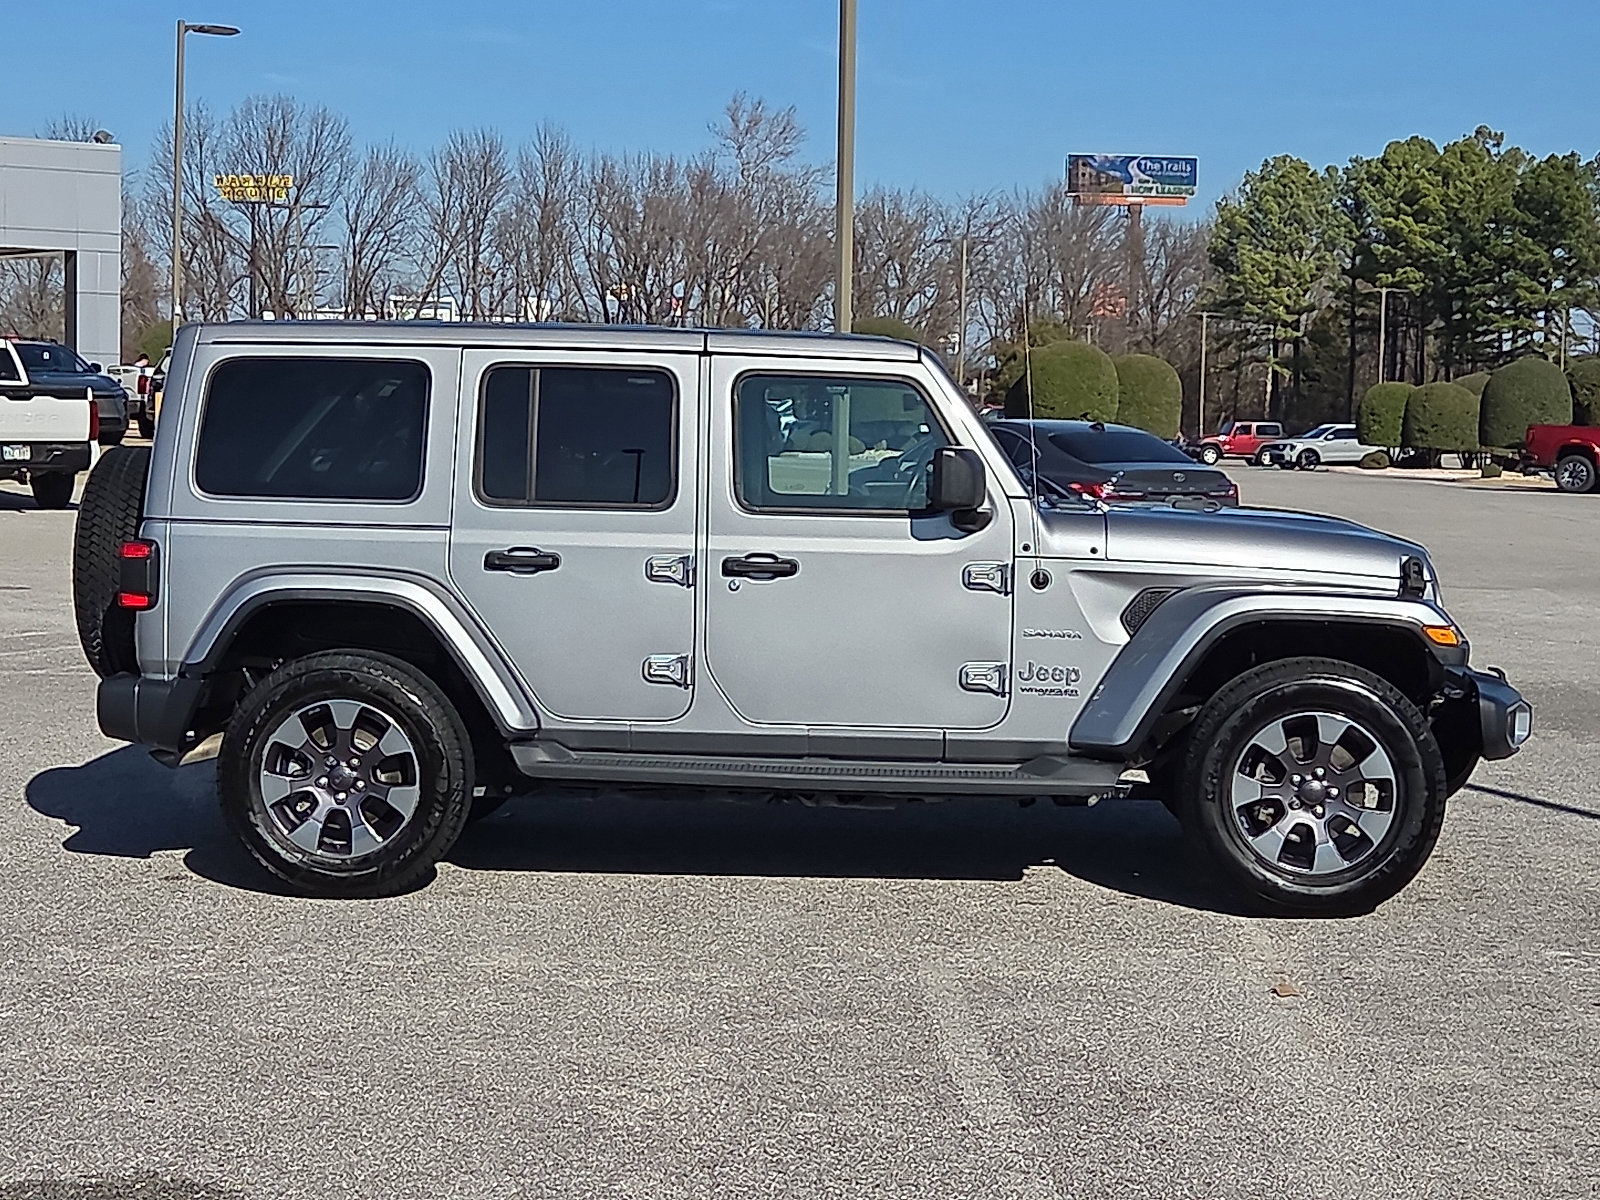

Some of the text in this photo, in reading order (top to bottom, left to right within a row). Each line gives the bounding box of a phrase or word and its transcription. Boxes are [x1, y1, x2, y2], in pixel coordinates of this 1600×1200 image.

[1140, 160, 1192, 172] The Trails
[1023, 629, 1082, 640] SAHARA
[1018, 661, 1081, 687] Jeep
